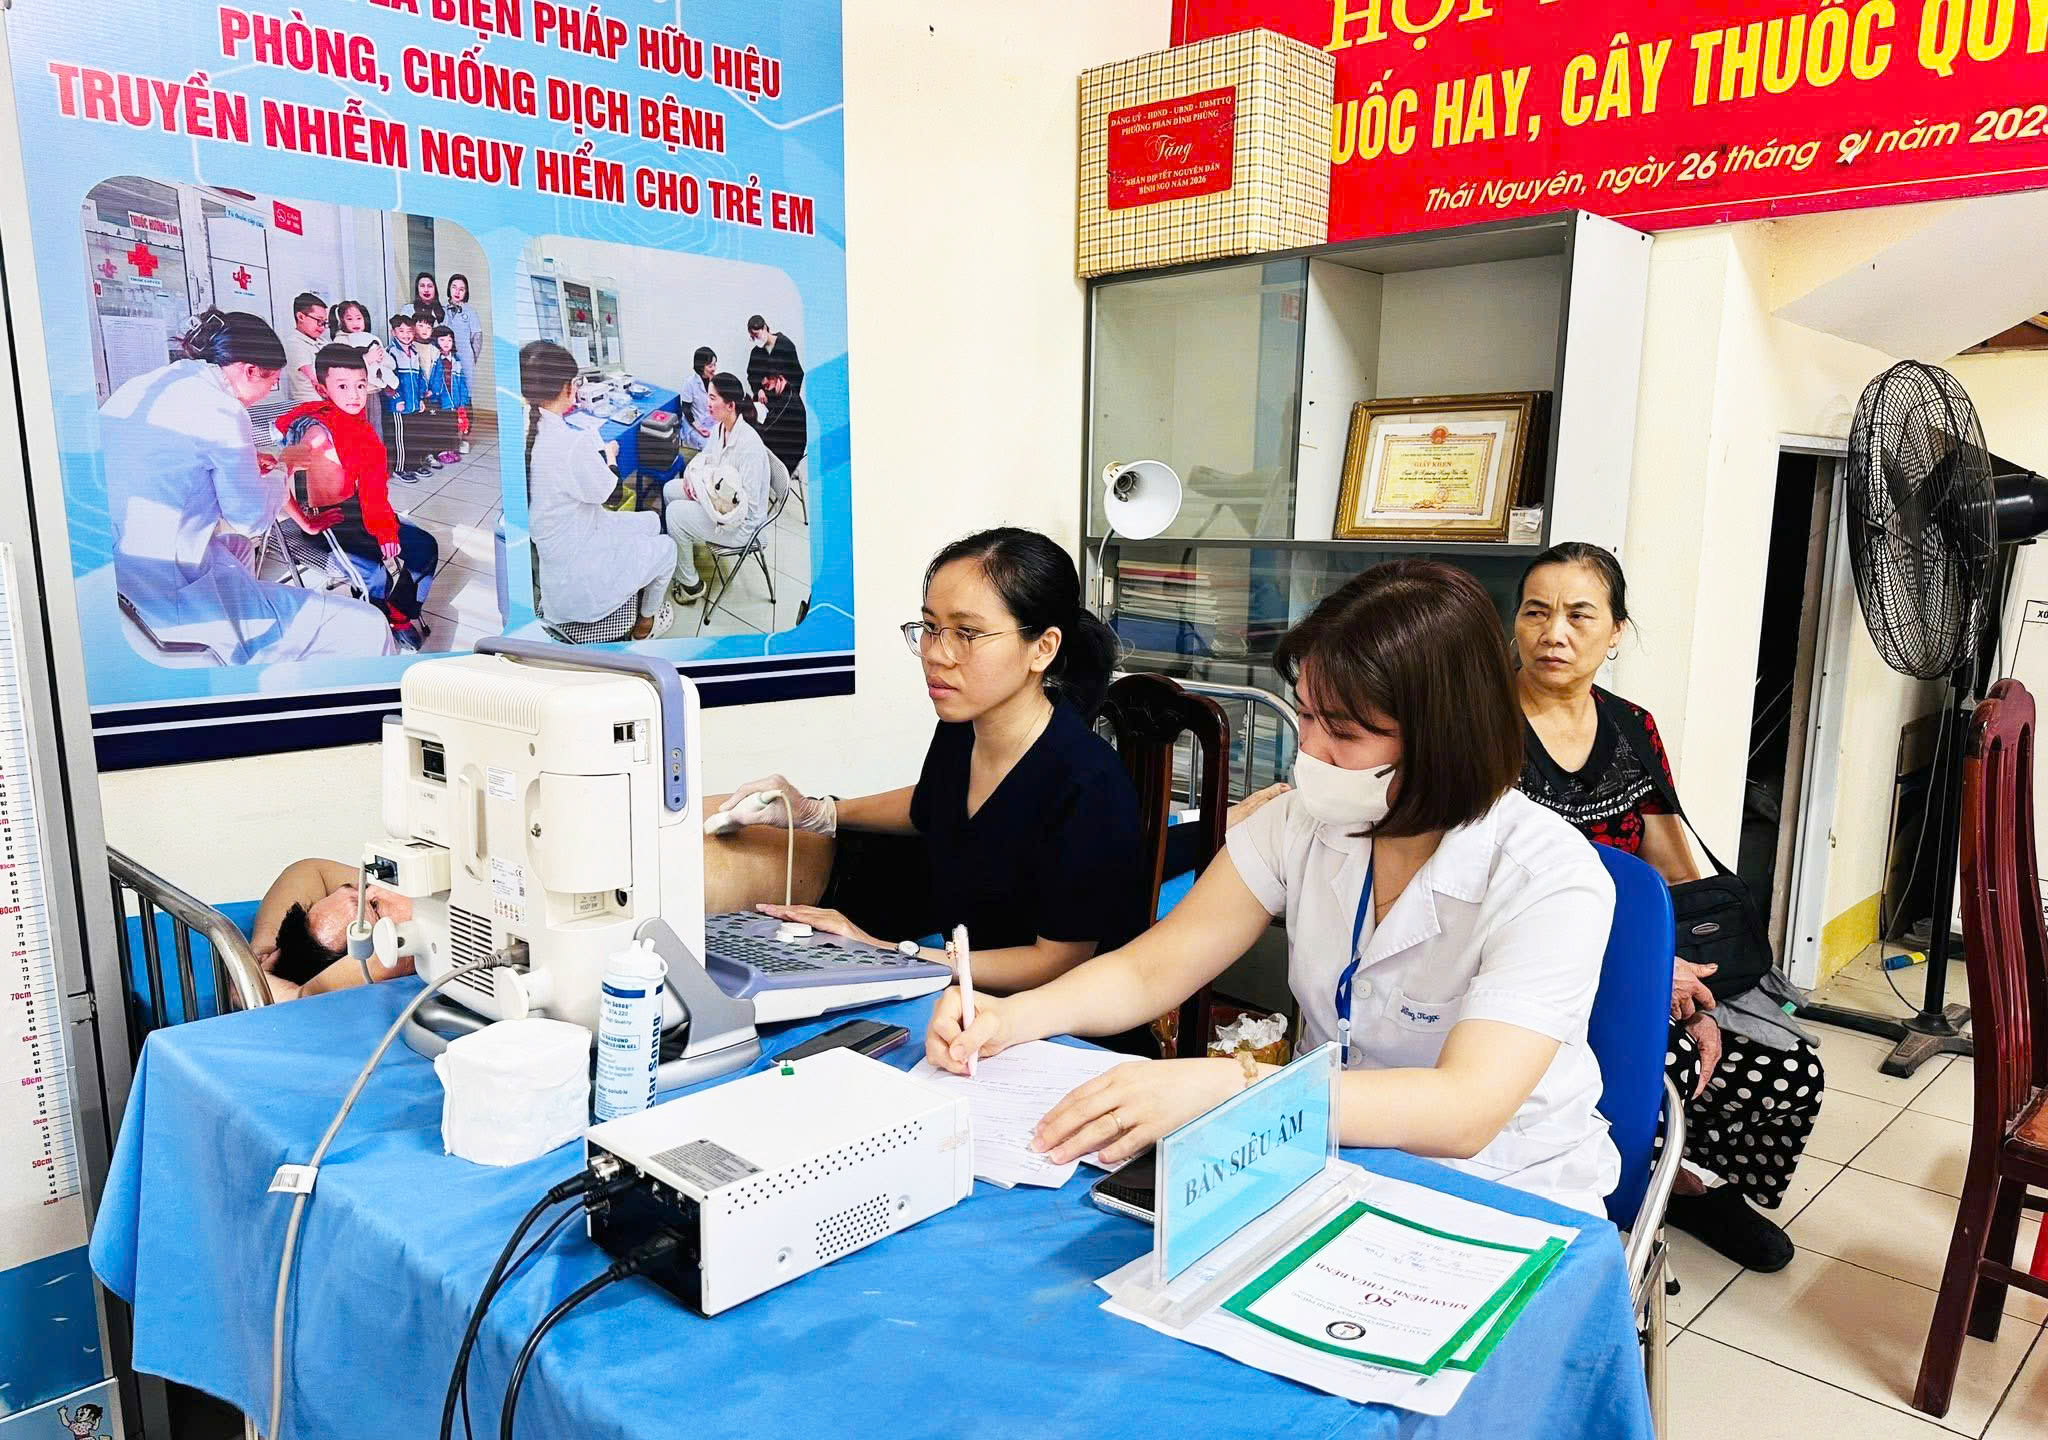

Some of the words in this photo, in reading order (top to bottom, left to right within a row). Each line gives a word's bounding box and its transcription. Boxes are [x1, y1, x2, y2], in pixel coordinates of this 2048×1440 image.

[220, 7, 389, 92] PHÒNG,
[403, 47, 536, 116] CHỐNG
[548, 78, 629, 134] DỊCH
[640, 96, 724, 152] BỆNH
[534, 0, 627, 59] PHÁP
[639, 26, 702, 79] HỮU
[713, 47, 780, 101] HIỆU
[1432, 65, 1541, 149] HAY,
[1561, 31, 1673, 127] CÂY
[49, 63, 249, 143] TRUYỀN
[264, 98, 407, 168] NHIỄM
[421, 129, 523, 186] NGUY
[536, 141, 624, 203] HIỂM
[636, 168, 698, 214] CHO
[708, 175, 762, 226] TRẺ
[772, 192, 814, 235] EM
[1145, 134, 1193, 164] Tặng
[1152, 119, 1172, 130] PHAN
[1174, 103, 1194, 114] UBND
[1189, 175, 1207, 186] 2026
[1424, 181, 1476, 212] Thái
[1478, 170, 1587, 208] Nguyên,
[1596, 156, 1677, 194] ngày
[1677, 151, 1718, 181] 26
[1723, 138, 1821, 173] tháng
[1875, 118, 1960, 153] năm
[1968, 104, 2048, 144] 202
[1229, 1129, 1271, 1176] SIÊU
[1276, 1108, 1303, 1148] ÂM
